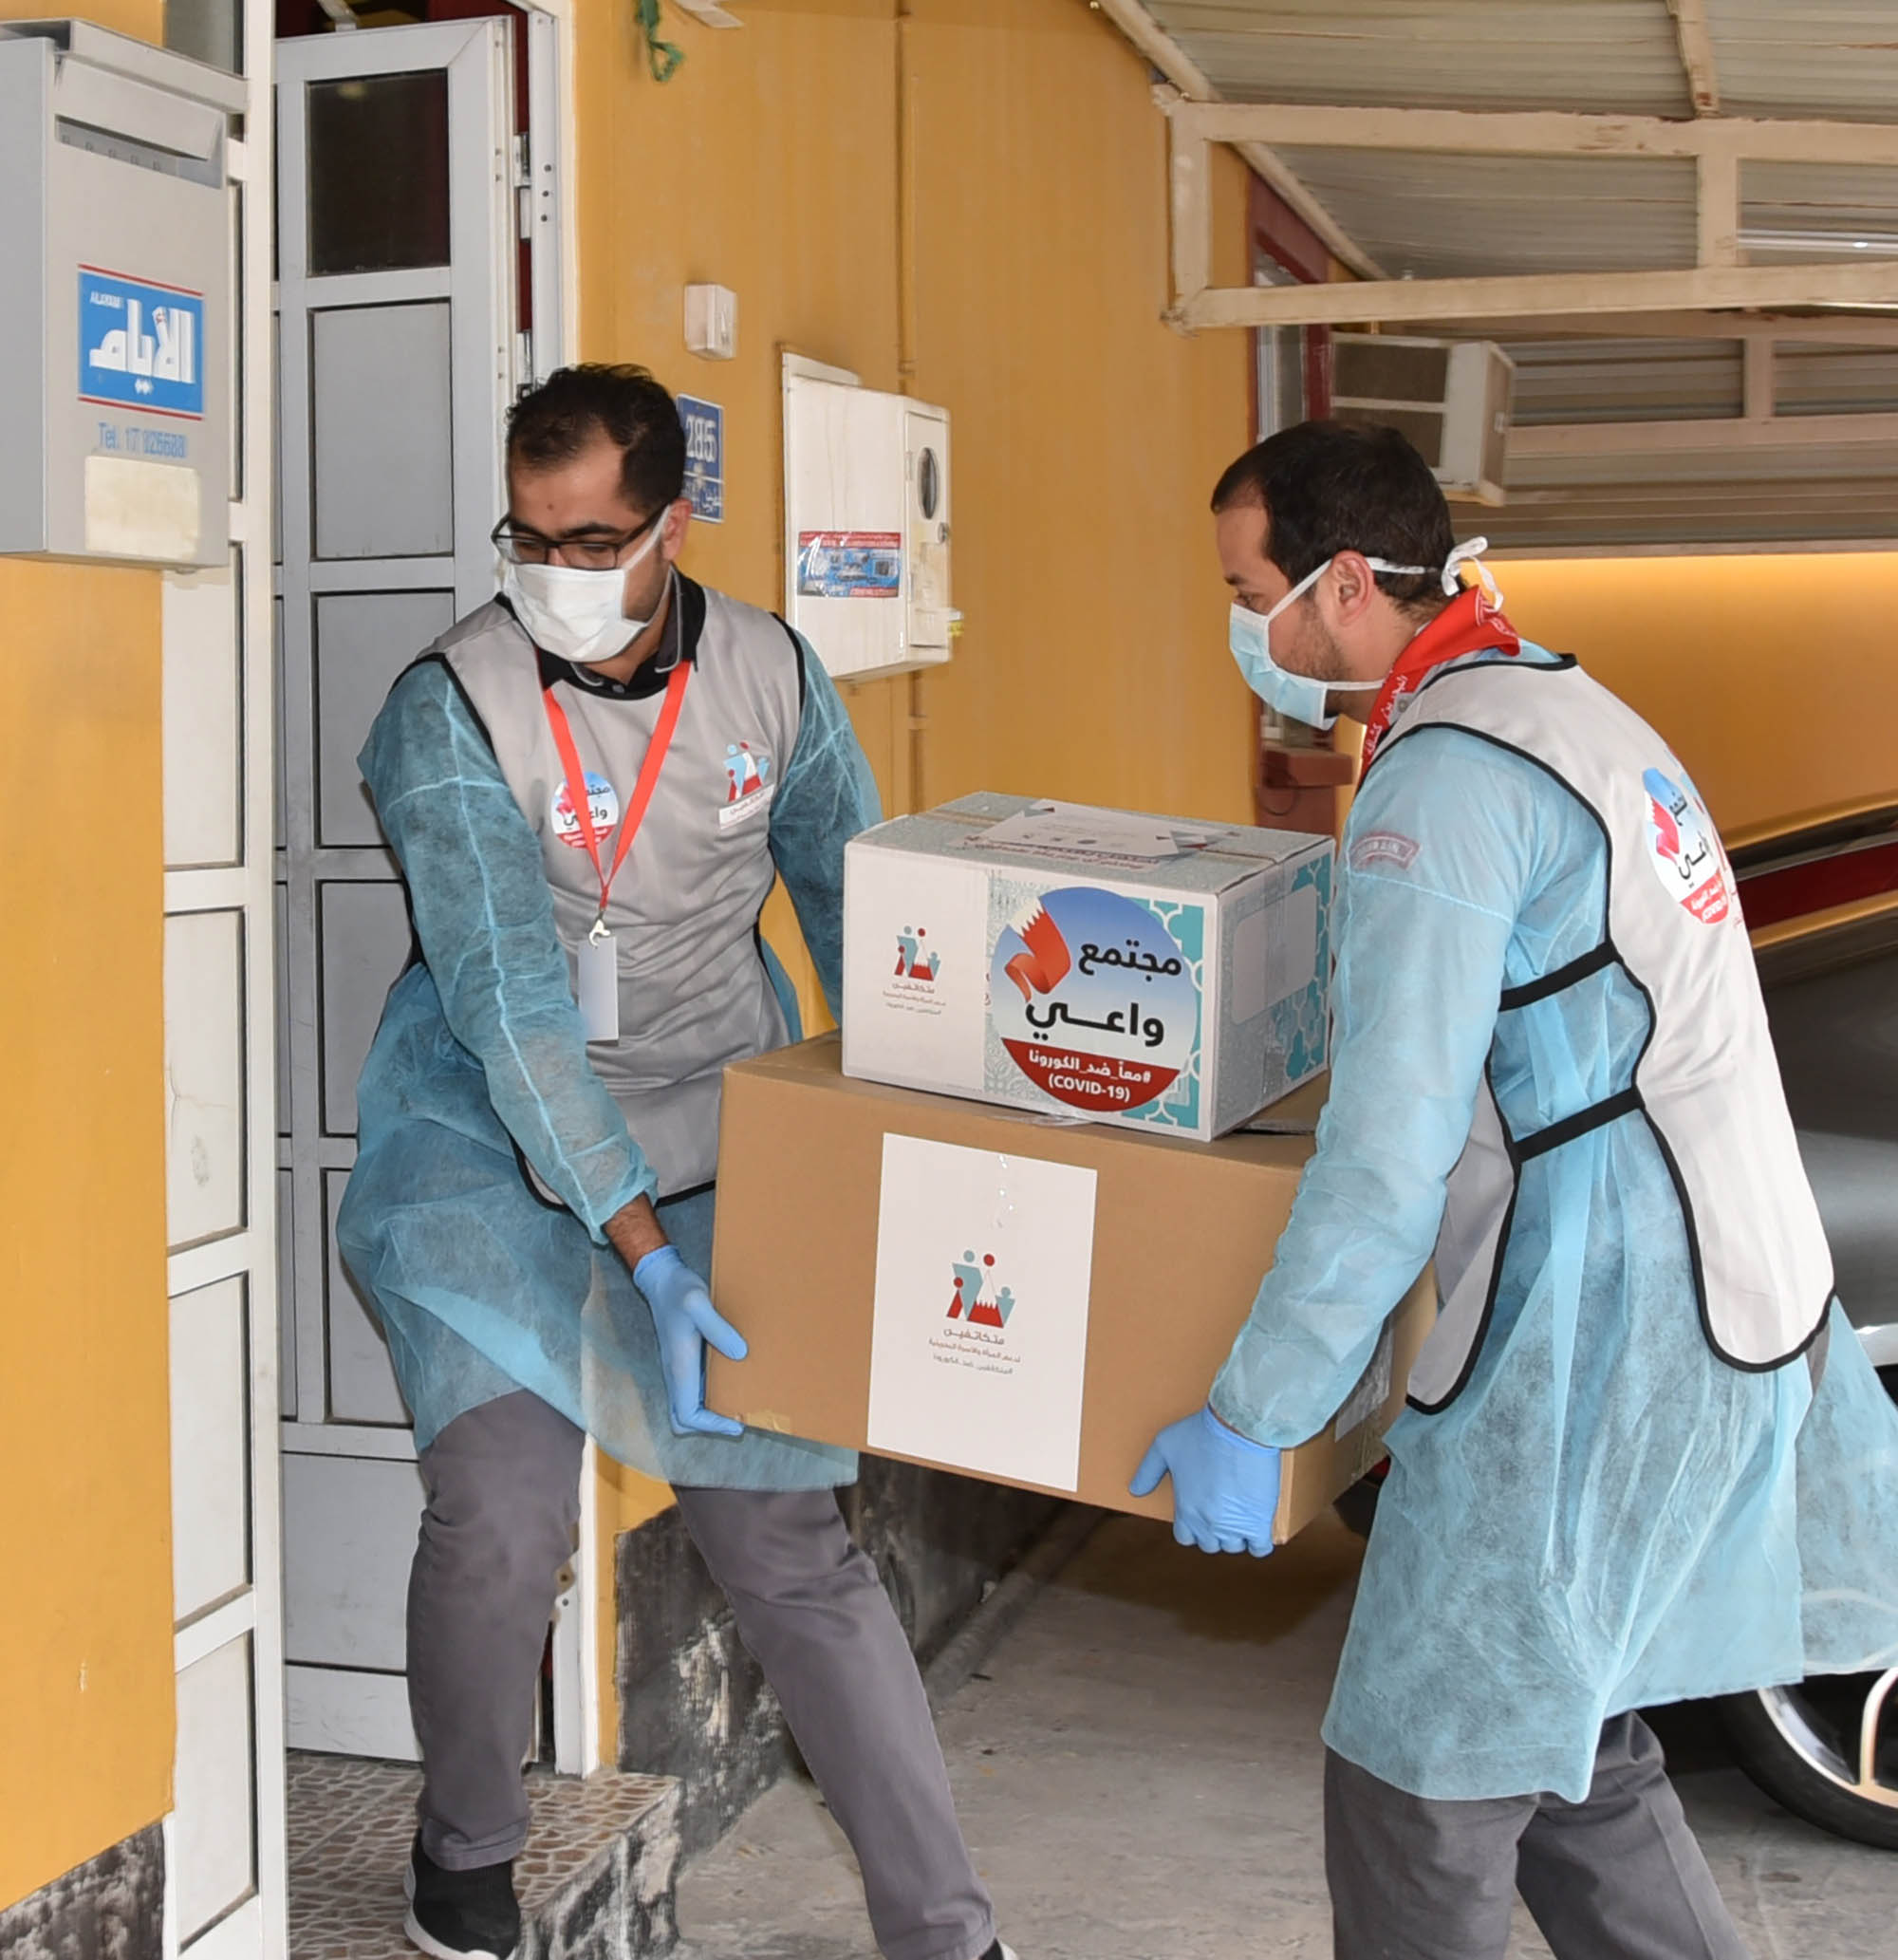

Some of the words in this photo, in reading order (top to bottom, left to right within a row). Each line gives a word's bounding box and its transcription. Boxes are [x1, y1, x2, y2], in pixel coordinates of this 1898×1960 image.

[1078, 939, 1182, 983] مجتمع
[1025, 1001, 1164, 1048] واعي
[1049, 1073, 1131, 1103] (COVID-19)
